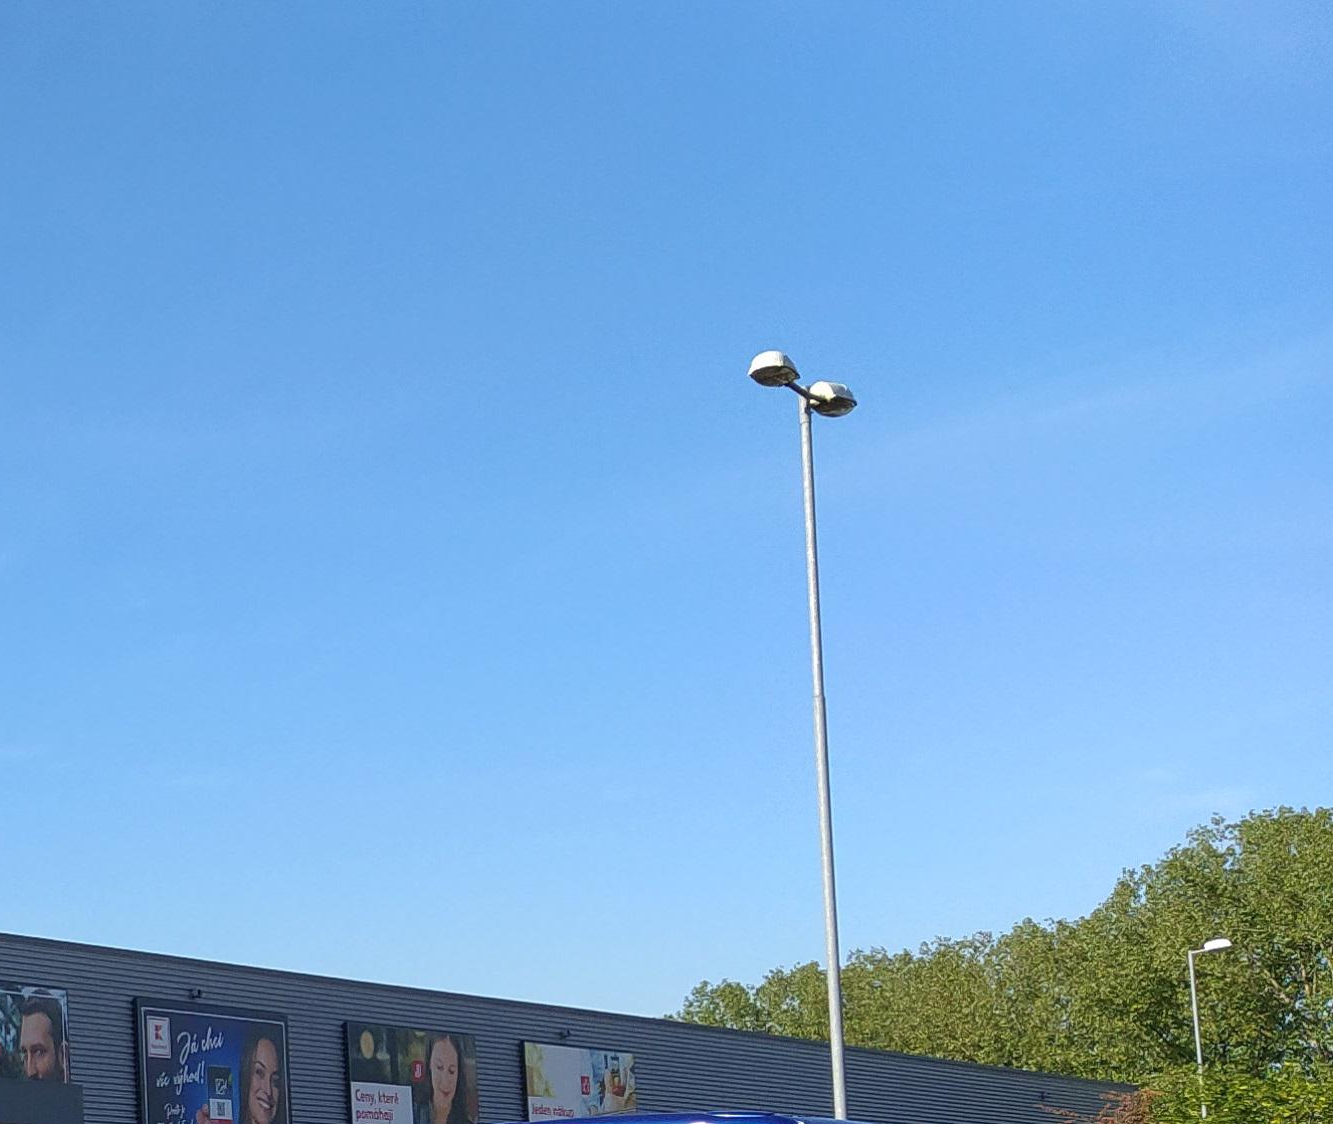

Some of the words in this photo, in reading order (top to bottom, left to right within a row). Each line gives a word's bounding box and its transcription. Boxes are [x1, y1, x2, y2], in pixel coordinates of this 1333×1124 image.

[177, 1031, 199, 1065] Já
[201, 1026, 224, 1052] chci
[173, 1061, 205, 1096] výhod!
[356, 1089, 377, 1105] Ceny,
